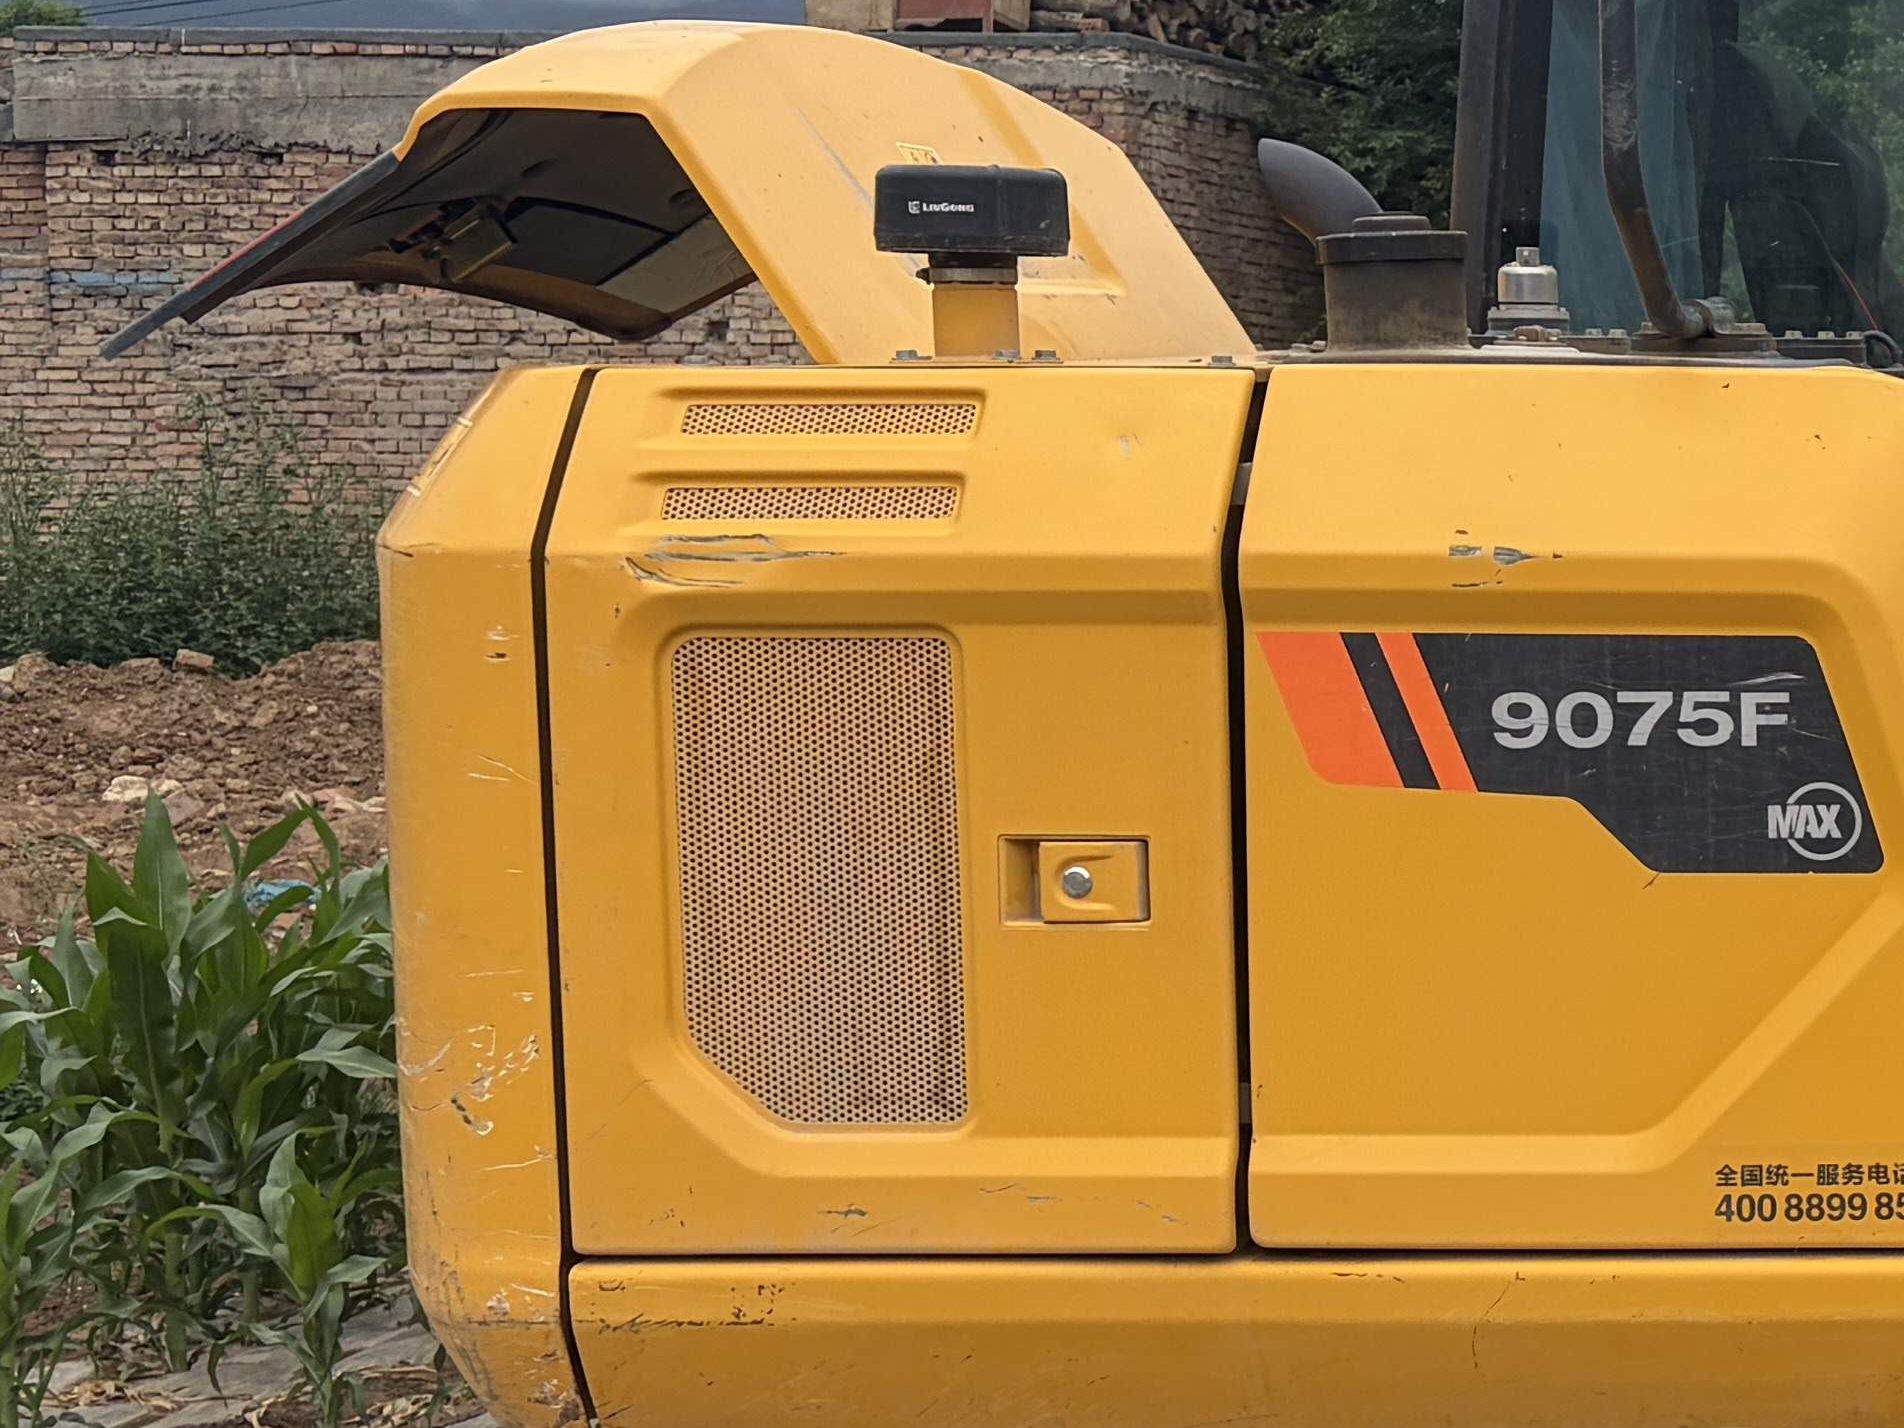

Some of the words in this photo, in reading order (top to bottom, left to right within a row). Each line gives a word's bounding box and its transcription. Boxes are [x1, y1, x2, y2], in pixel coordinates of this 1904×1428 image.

[1492, 691, 1791, 748] 9075F
[1768, 804, 1843, 839] MAX
[1715, 1194, 1777, 1222] 400
[1784, 1193, 1867, 1222] 8899
